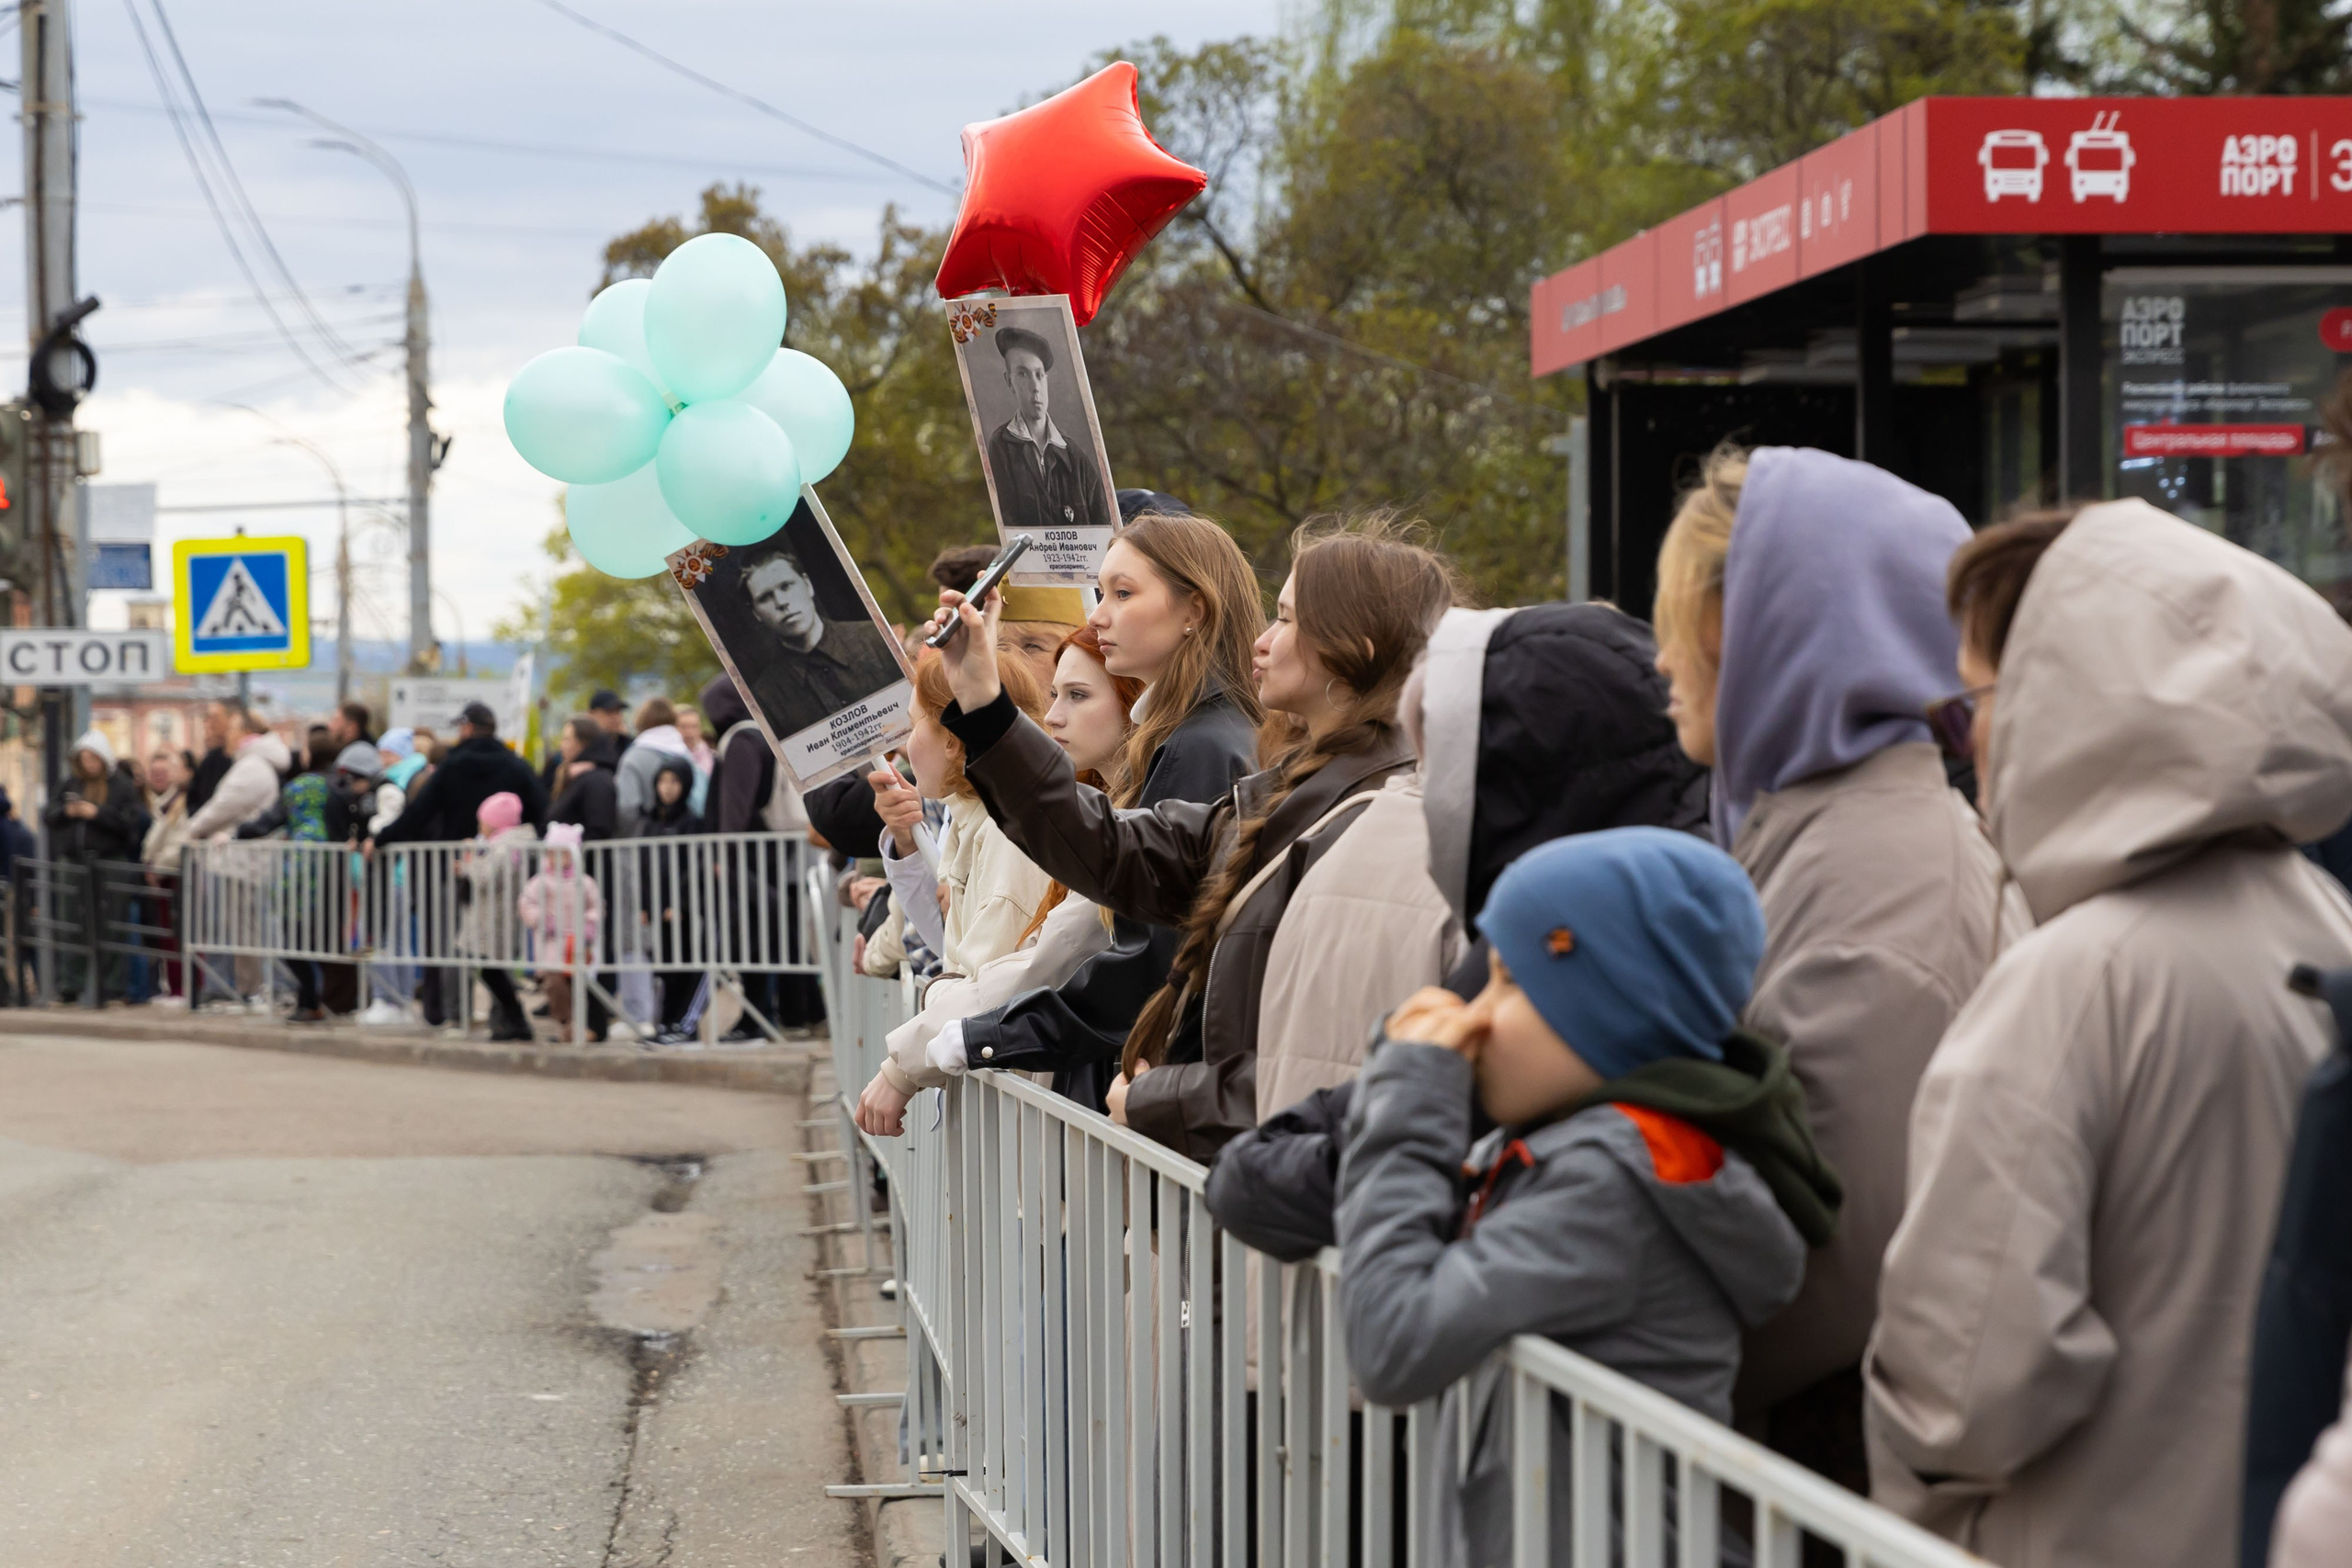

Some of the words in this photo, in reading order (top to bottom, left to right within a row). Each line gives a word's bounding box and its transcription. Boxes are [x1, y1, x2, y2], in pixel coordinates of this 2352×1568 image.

[2221, 134, 2298, 165] АЭРО
[2220, 164, 2298, 197] ПОРТ
[2122, 297, 2185, 321] АЭРО
[2120, 321, 2185, 347] ПОРТ
[1029, 542, 1057, 553] Андрей
[1059, 542, 1097, 551] Иванович
[1045, 531, 1078, 541] КОЗЛОВ
[1043, 553, 1089, 563] 1923-1942гг.
[9, 640, 150, 675] СТОП
[806, 737, 830, 753] Иван
[830, 702, 899, 741] Климентьевич
[829, 704, 868, 729] КОЗЛОВ
[831, 721, 886, 751] 1904-1942гг.
